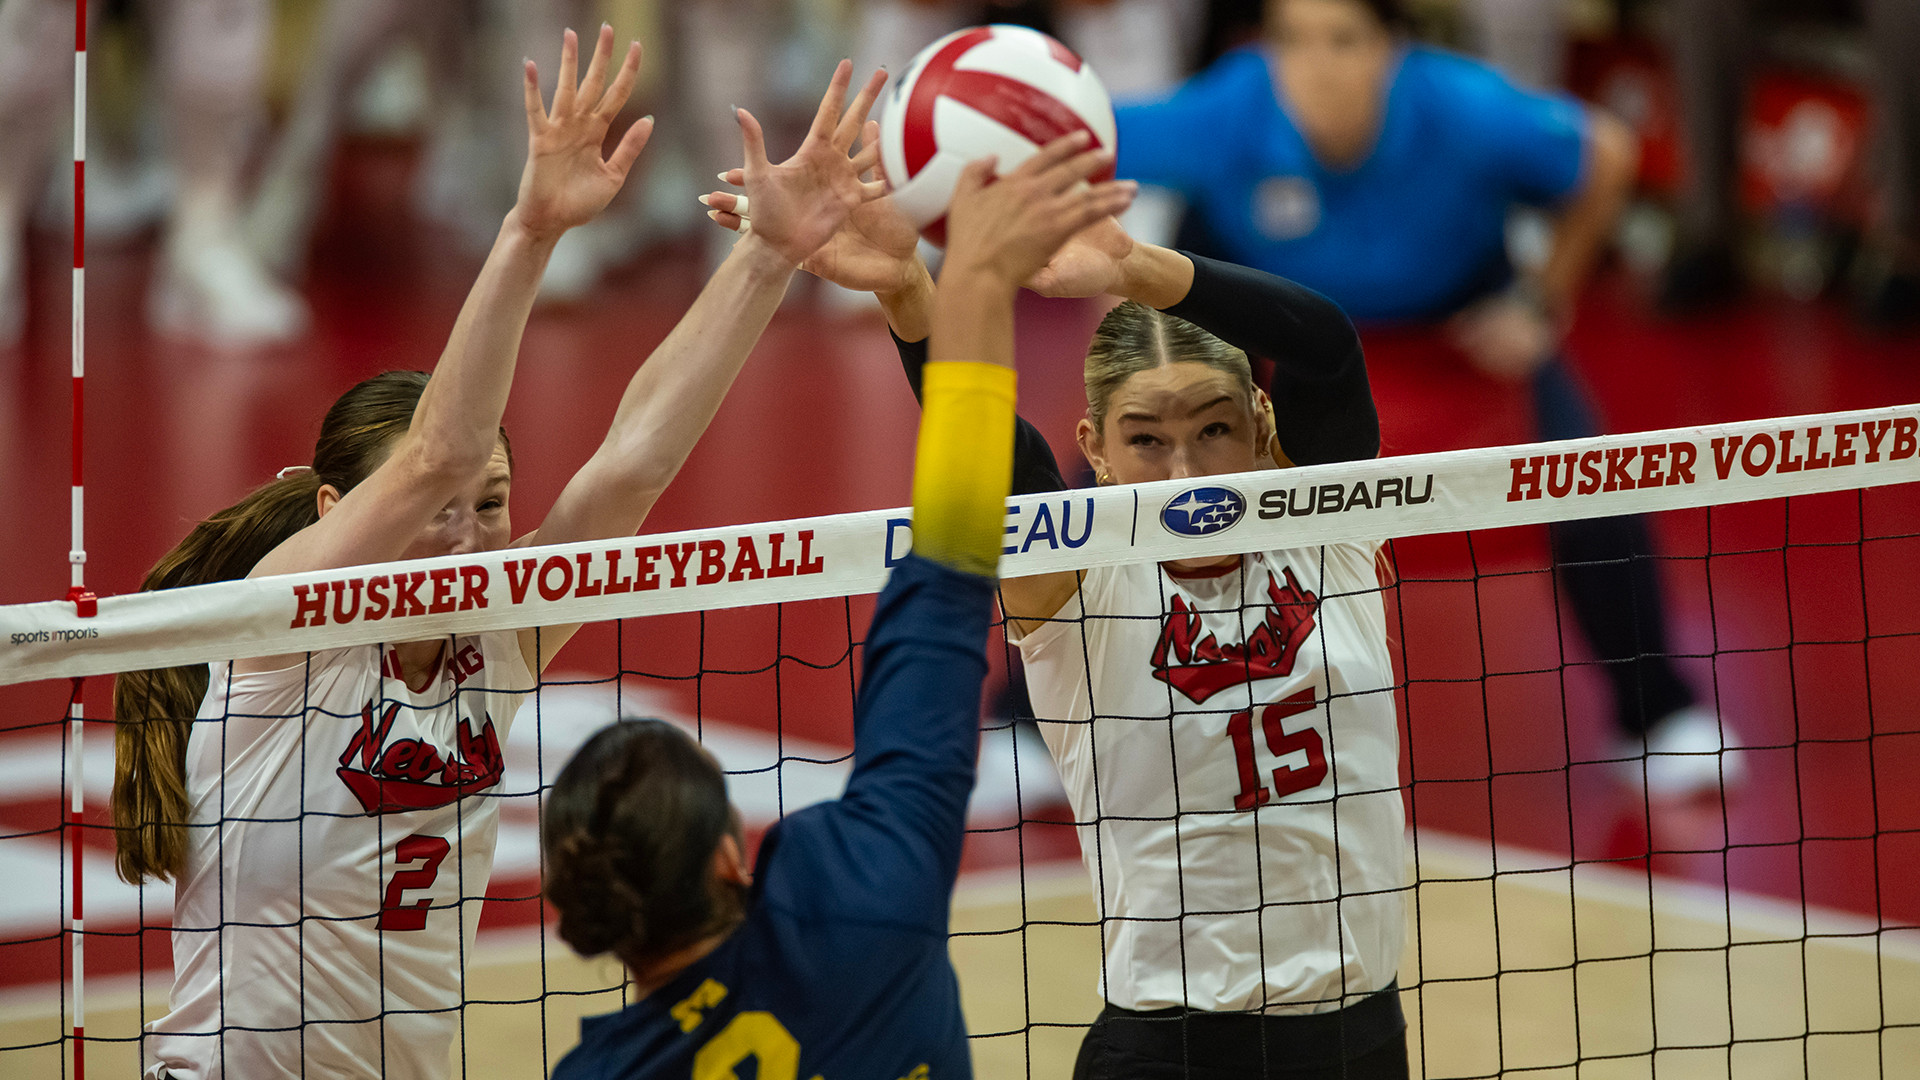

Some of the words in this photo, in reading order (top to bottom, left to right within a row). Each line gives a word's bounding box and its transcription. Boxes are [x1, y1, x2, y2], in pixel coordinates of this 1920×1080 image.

[1257, 474, 1434, 520] SUBARU
[1507, 441, 1697, 502] HUSKER
[1711, 416, 1920, 481] VOLLEYB
[884, 497, 1095, 569] DEAU
[290, 565, 489, 629] HUSKER
[503, 529, 825, 605] VOLLEYBALL
[10, 630, 50, 646] sports
[51, 627, 99, 643] imports
[1225, 685, 1329, 812] 15
[375, 833, 451, 932] 2
